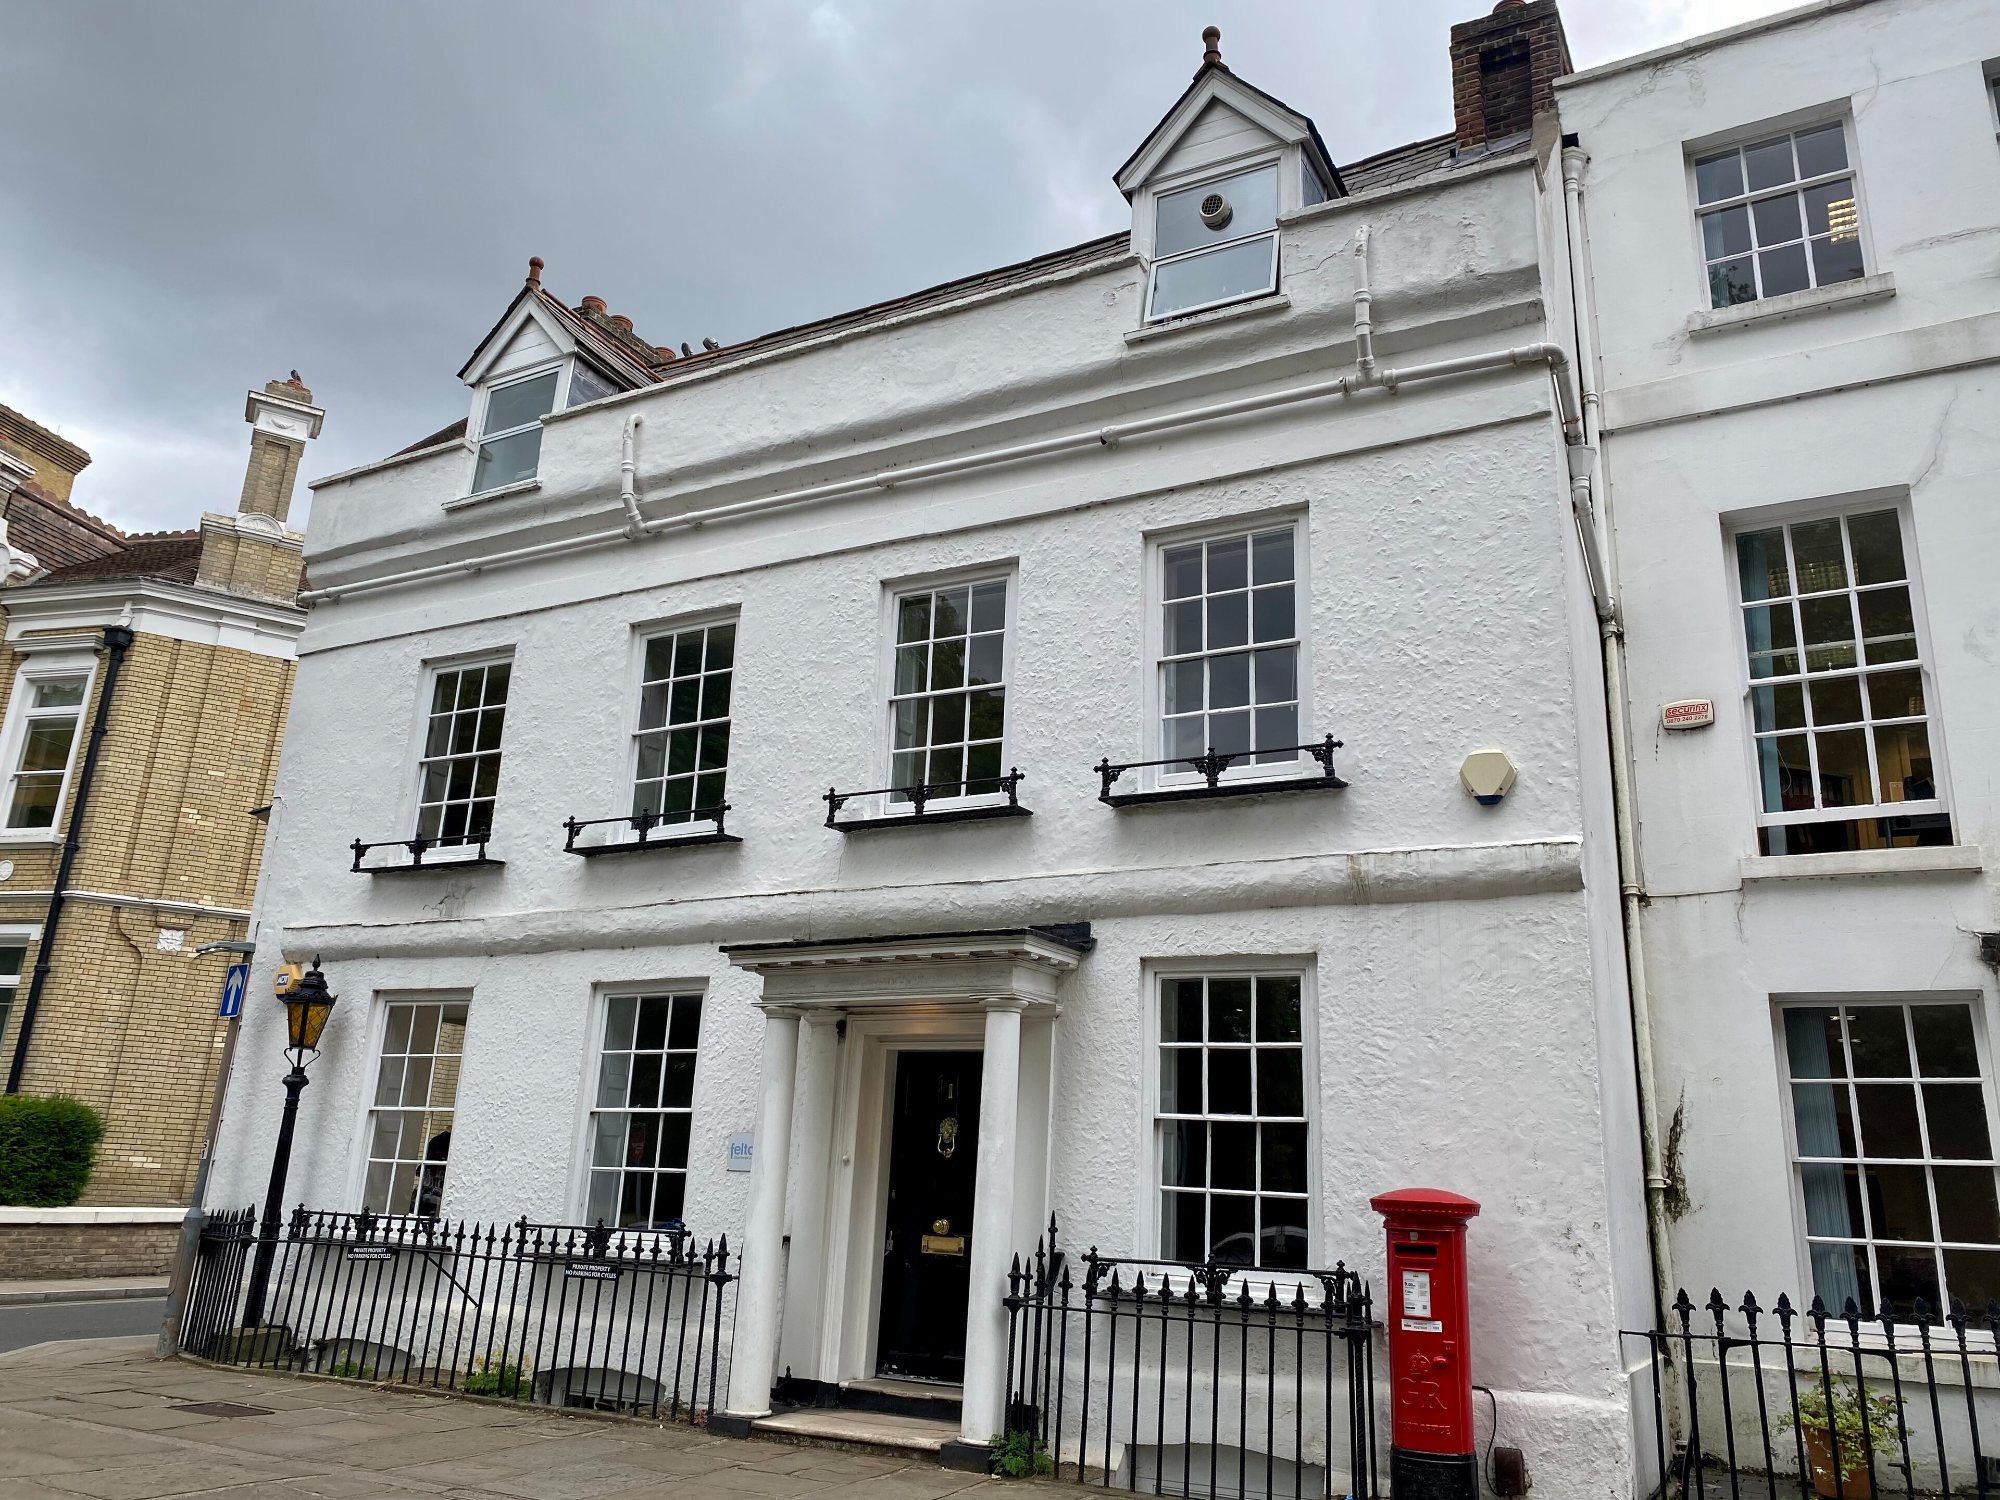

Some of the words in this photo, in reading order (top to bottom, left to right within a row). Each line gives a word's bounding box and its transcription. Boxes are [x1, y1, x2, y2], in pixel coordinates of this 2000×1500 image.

[572, 1263, 589, 1271] PRIVATE
[588, 1265, 611, 1273] PROPERTY
[572, 1270, 592, 1278] PARKING
